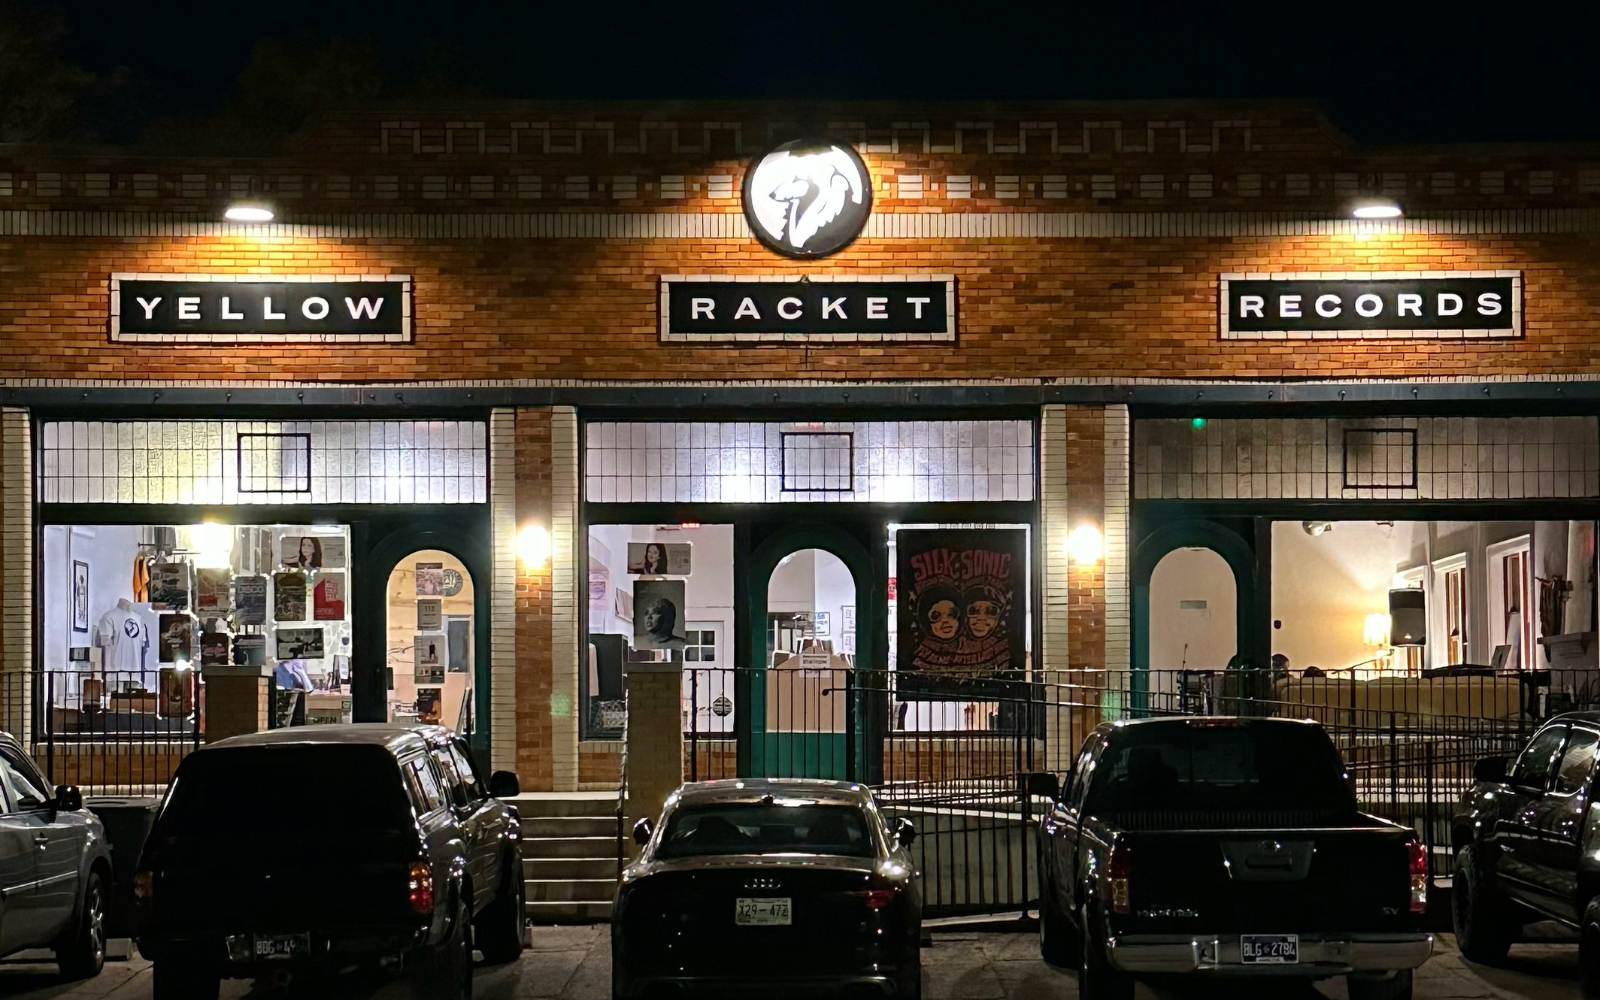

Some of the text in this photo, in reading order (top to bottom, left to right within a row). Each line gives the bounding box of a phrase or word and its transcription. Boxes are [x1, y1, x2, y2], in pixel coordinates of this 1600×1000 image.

[136, 292, 1503, 320] YELLOW RACKET RECORDS
[911, 548, 1011, 581] SILK SONIC
